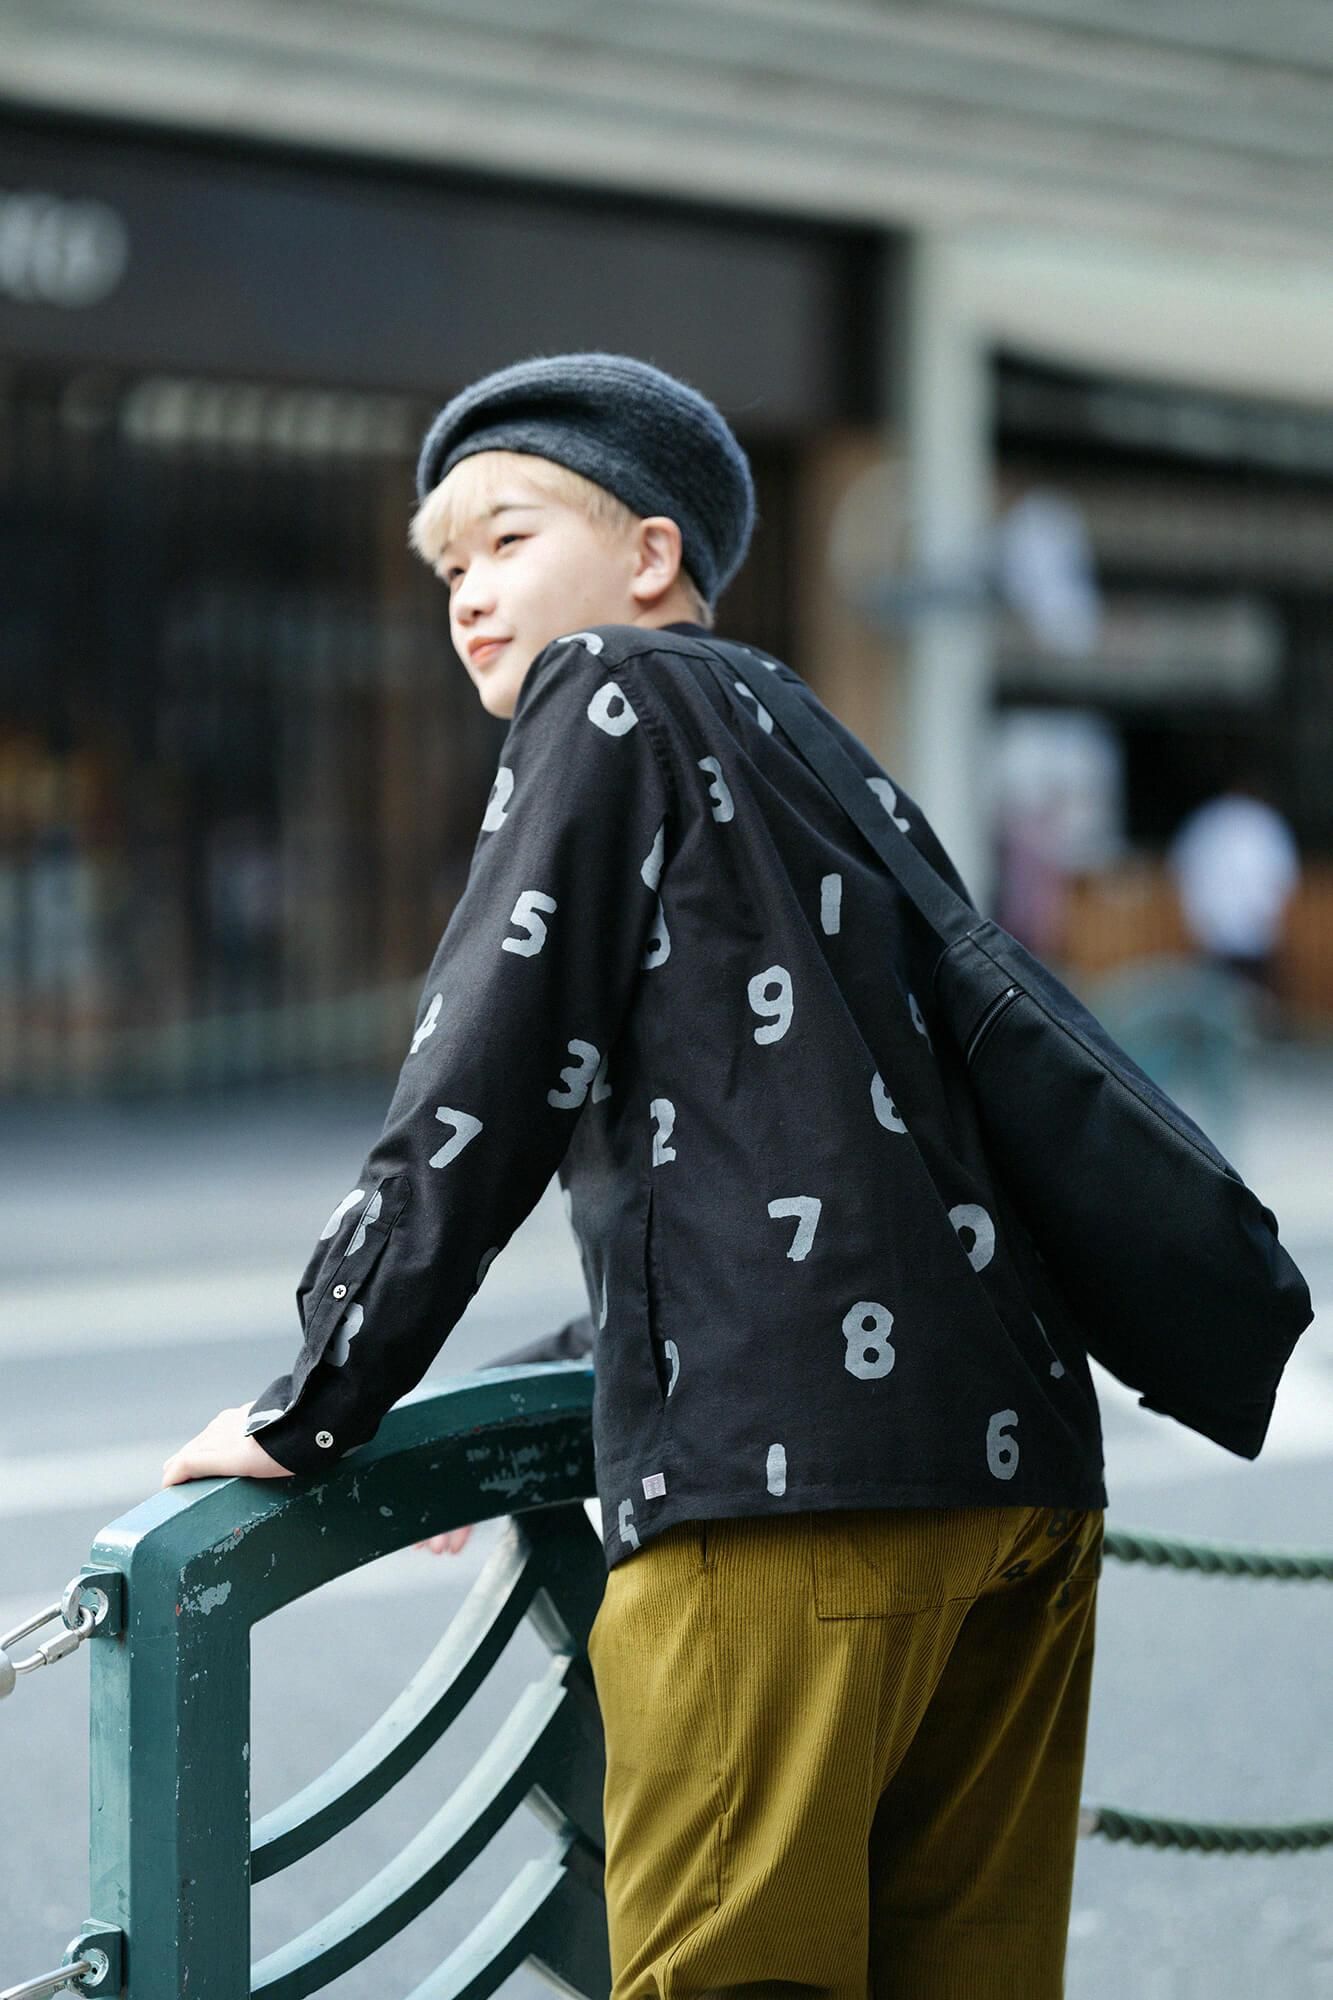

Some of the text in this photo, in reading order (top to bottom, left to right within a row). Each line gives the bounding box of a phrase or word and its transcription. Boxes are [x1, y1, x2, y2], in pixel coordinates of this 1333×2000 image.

[697, 756, 735, 823] 3
[502, 890, 557, 958] 5
[747, 964, 794, 1045] 9
[547, 1038, 600, 1109] 3
[429, 1106, 483, 1169] 7
[650, 1098, 677, 1168] 2
[768, 1195, 822, 1262] 7
[842, 1301, 896, 1380] 8
[986, 1409, 1020, 1480] 6
